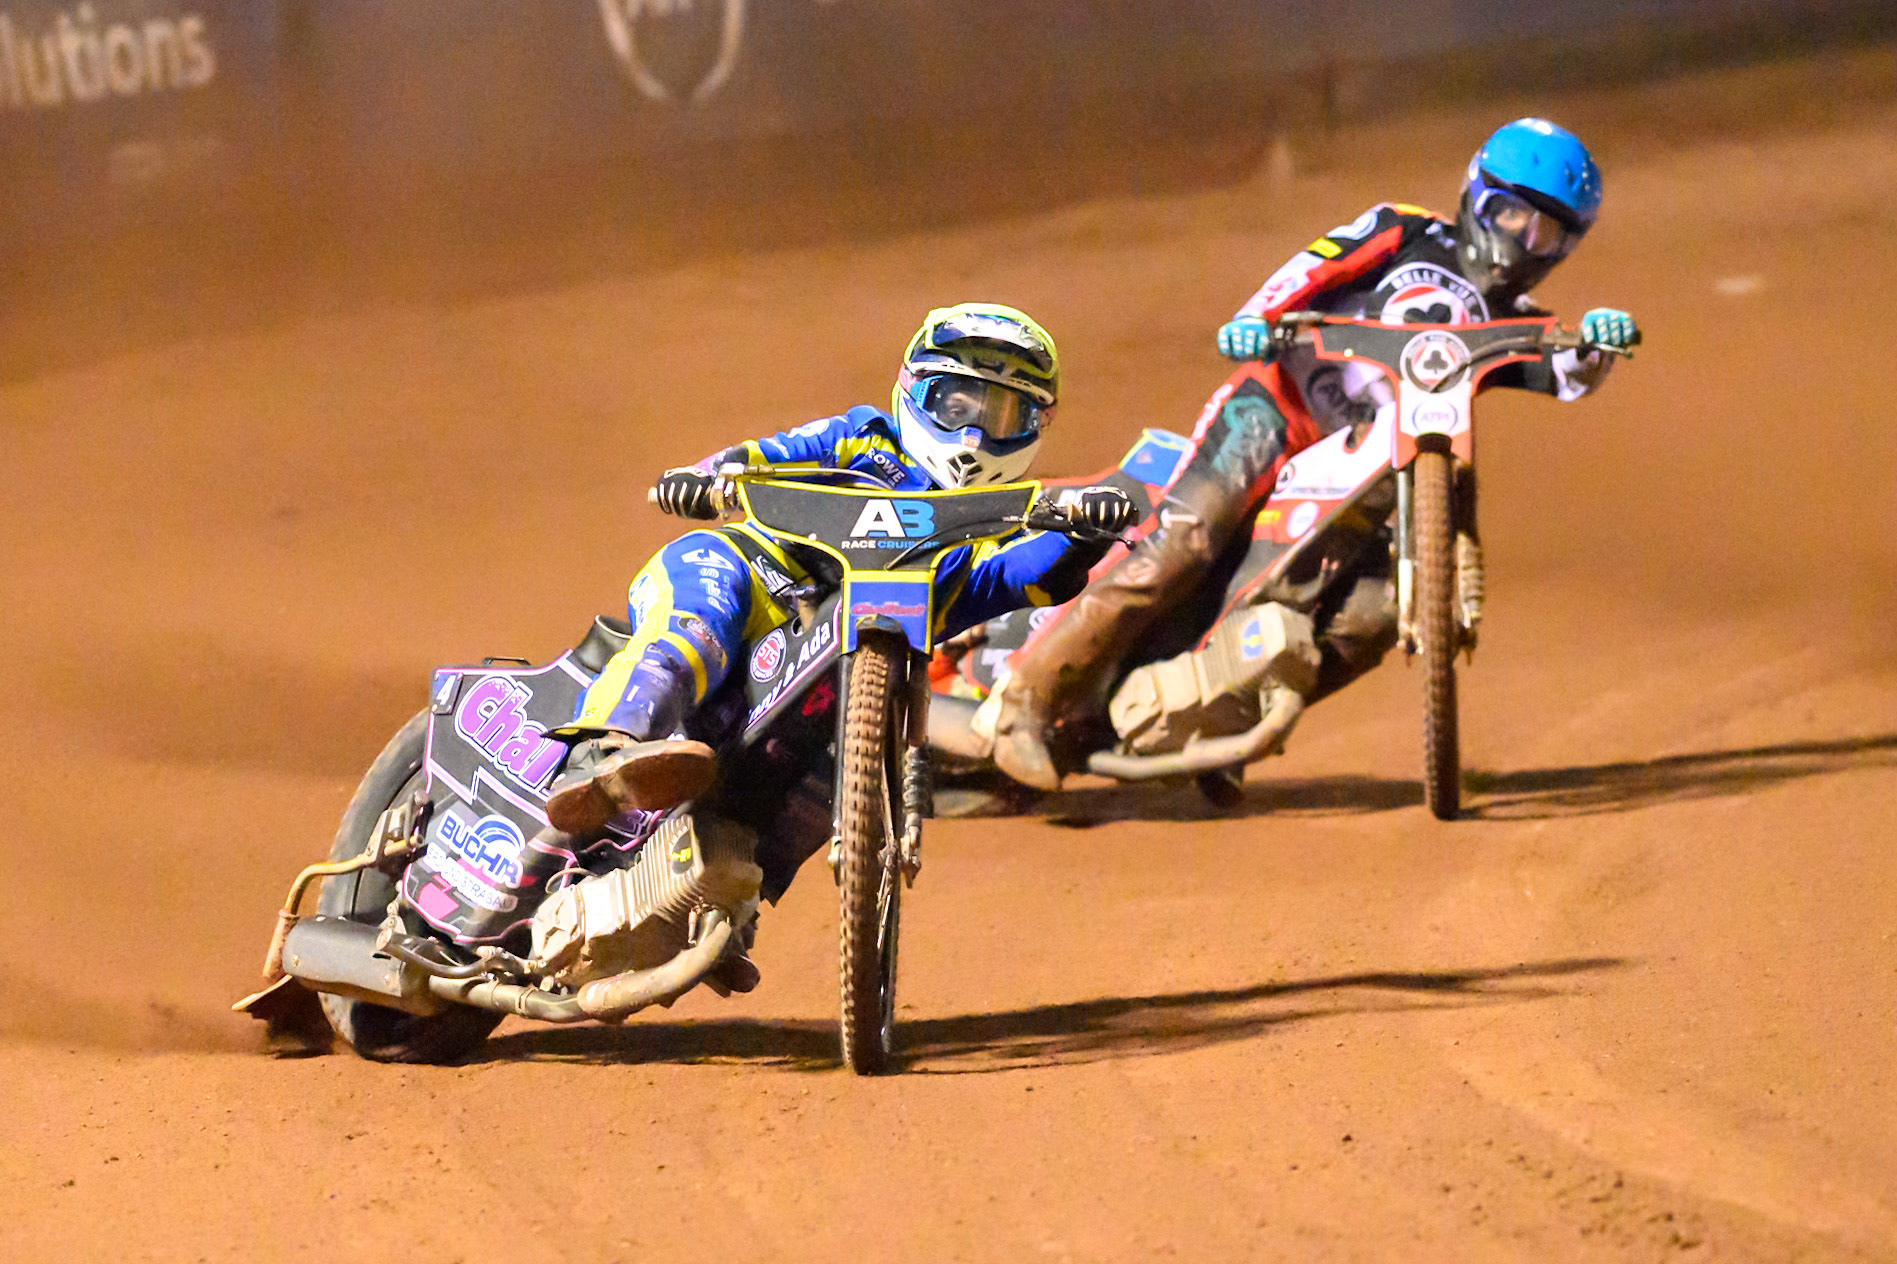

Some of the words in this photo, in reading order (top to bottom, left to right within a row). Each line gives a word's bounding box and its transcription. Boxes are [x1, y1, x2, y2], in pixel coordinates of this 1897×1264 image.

[865, 447, 905, 483] ROWE
[849, 499, 935, 538] AB
[841, 541, 876, 549] RACE
[759, 643, 779, 666] STS
[796, 621, 831, 671] Ada
